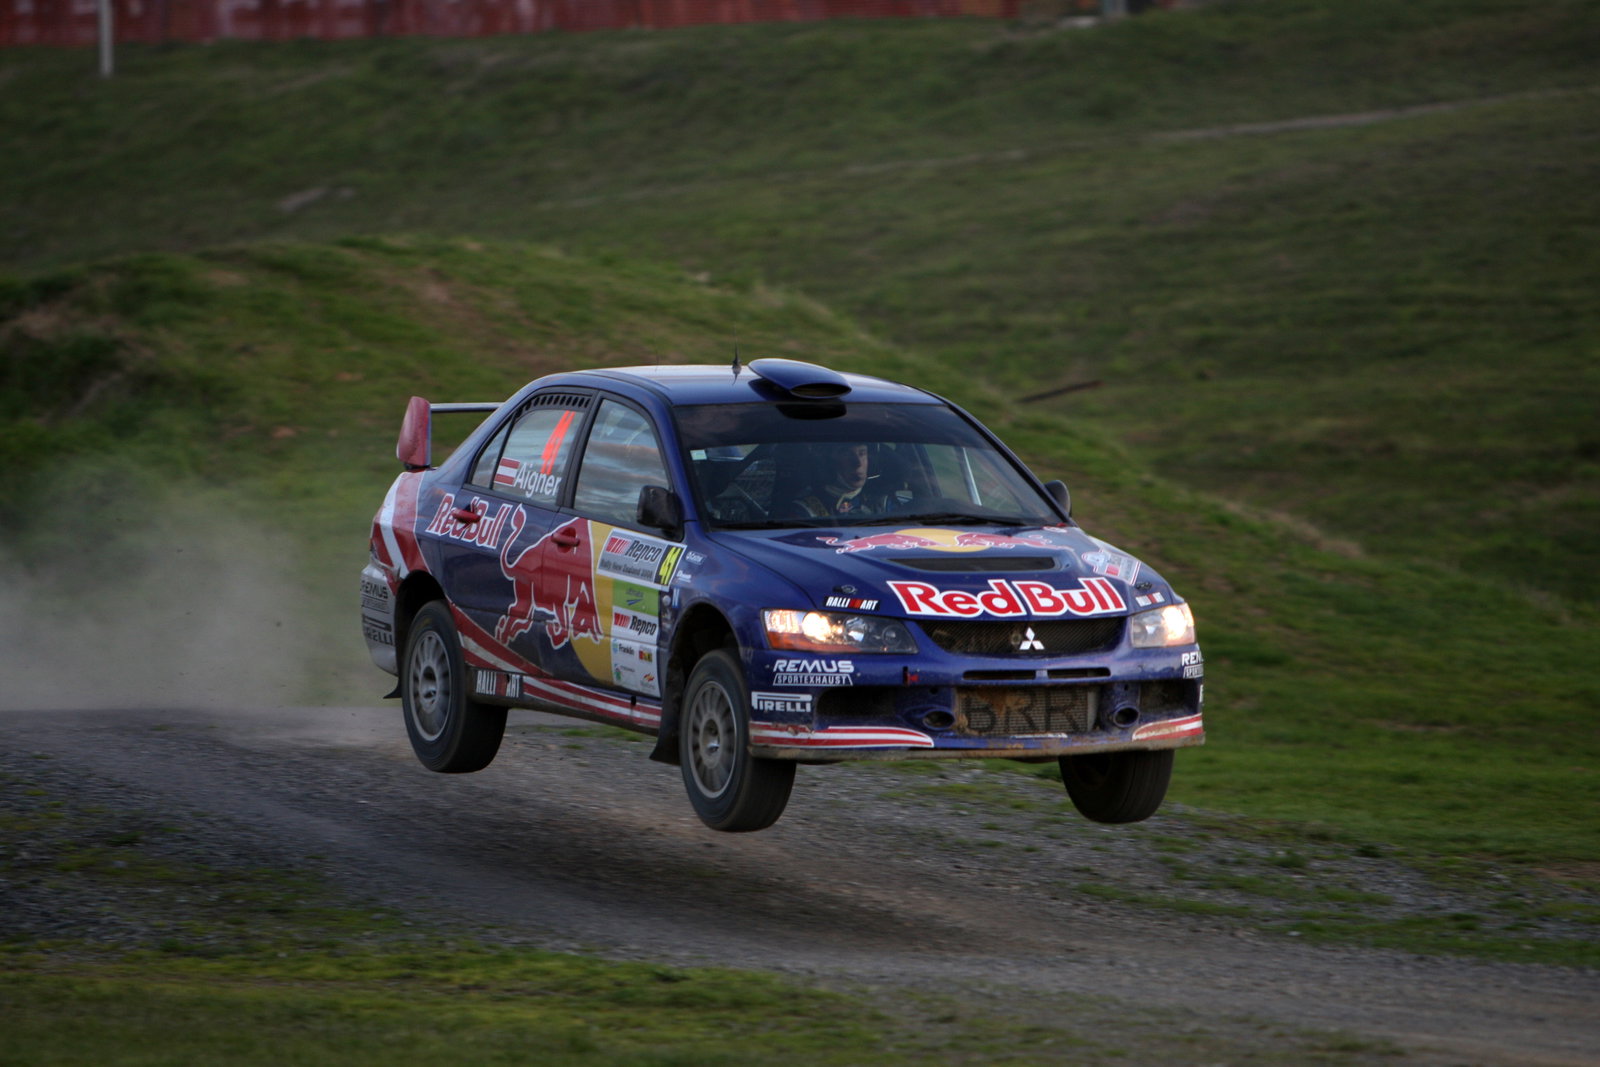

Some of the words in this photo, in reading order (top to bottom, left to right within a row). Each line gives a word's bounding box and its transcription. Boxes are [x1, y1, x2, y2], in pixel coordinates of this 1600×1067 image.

[513, 462, 562, 498] Aigner
[461, 500, 513, 549] Bull
[625, 540, 662, 562] Repco
[886, 579, 1027, 618] Red
[1012, 577, 1127, 616] Bull
[630, 615, 657, 635] Repco
[773, 659, 854, 673] REMUS
[776, 674, 848, 686] SPORTEXHAUST
[751, 691, 813, 712] PIRELLI
